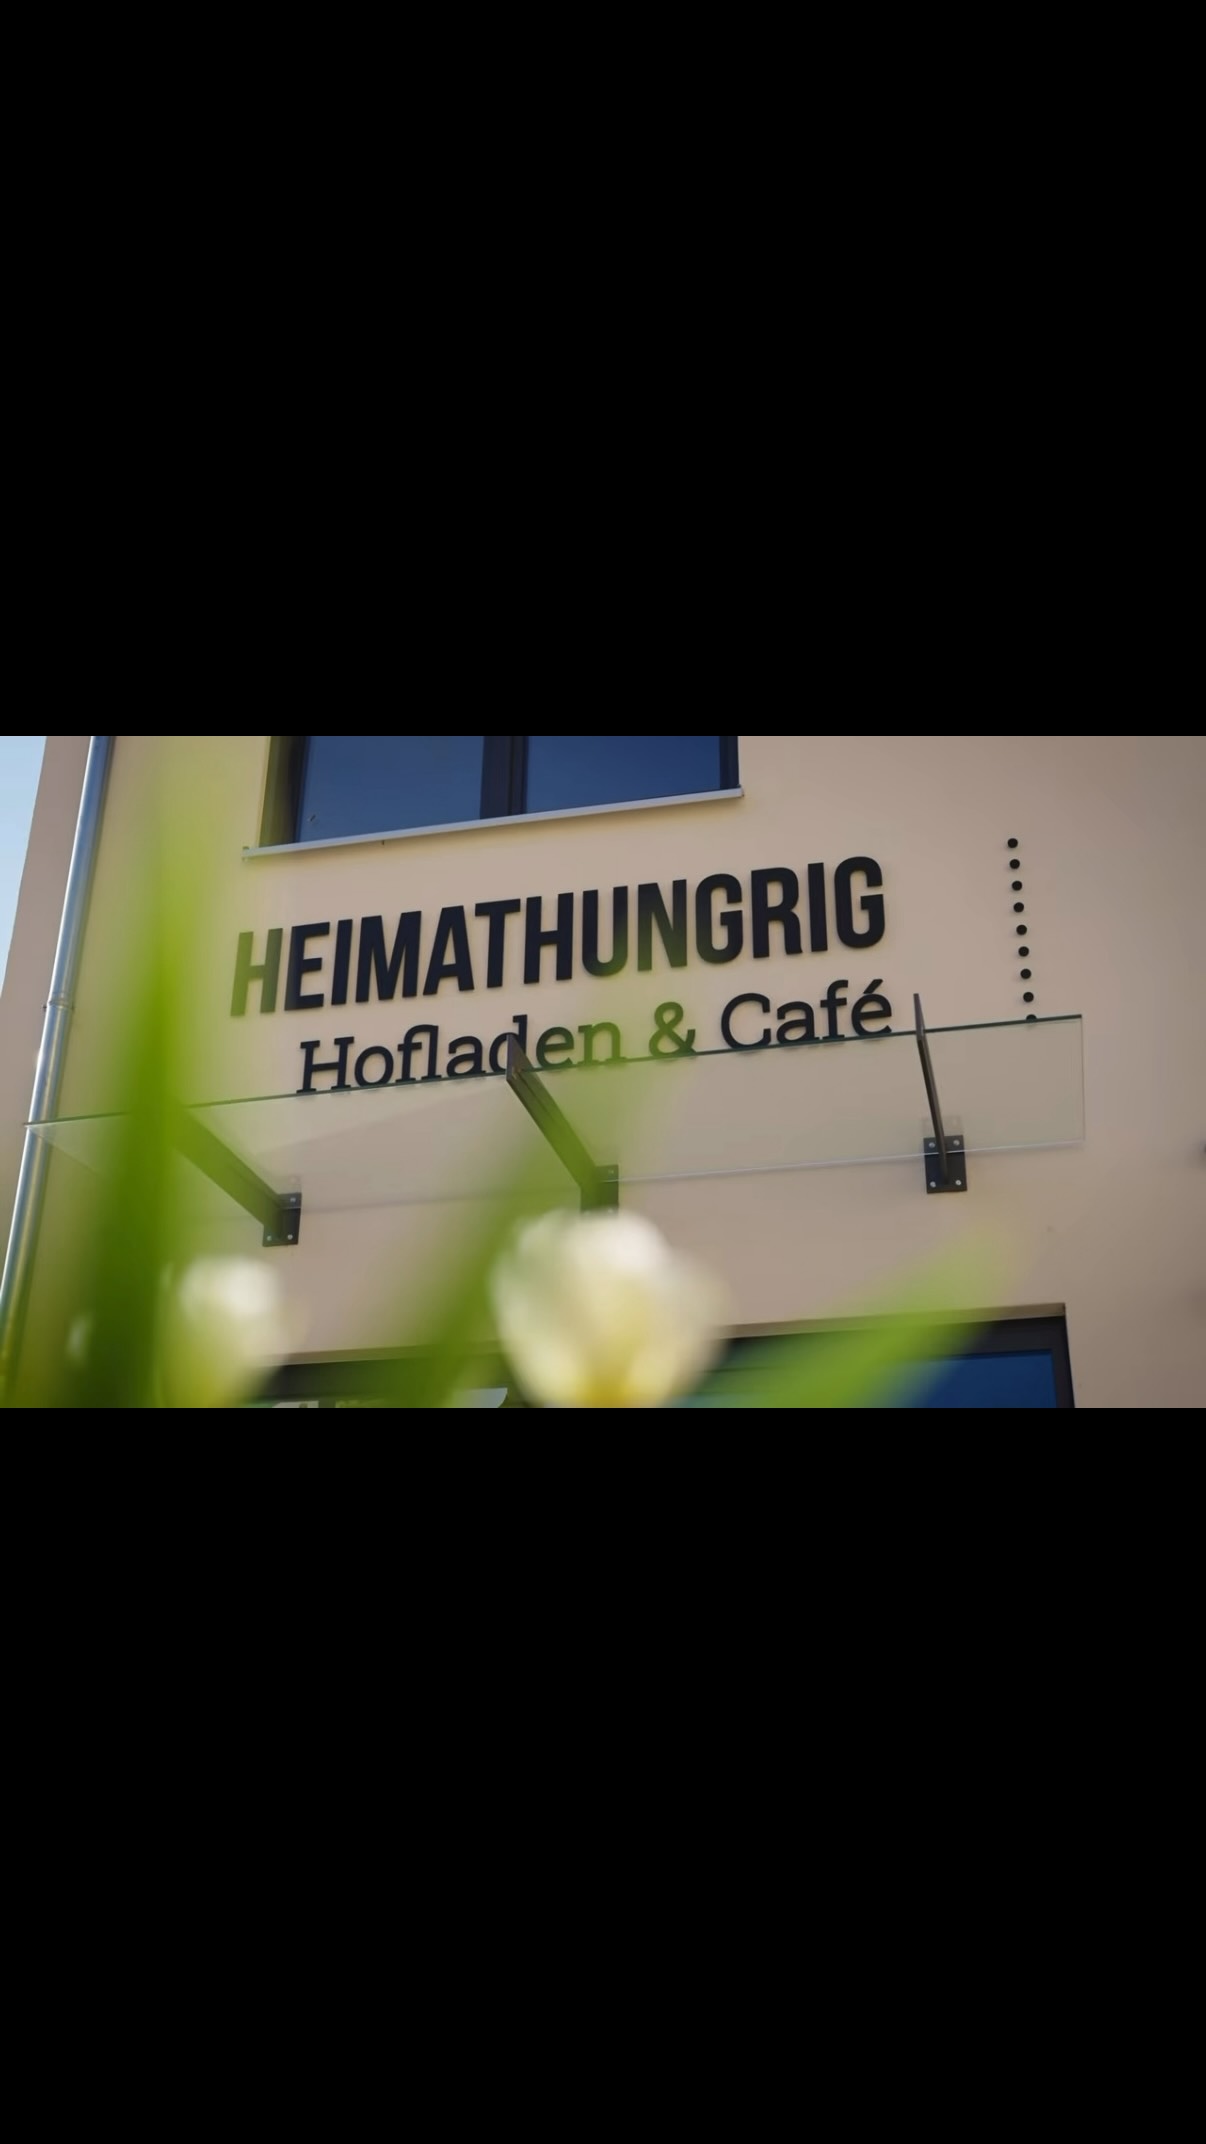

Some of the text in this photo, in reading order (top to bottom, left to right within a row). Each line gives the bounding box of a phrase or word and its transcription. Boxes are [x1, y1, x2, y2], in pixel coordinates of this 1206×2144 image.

[230, 856, 886, 1017] HEIMATHUNGRIG
[296, 979, 893, 1094] Hofladen & Café
